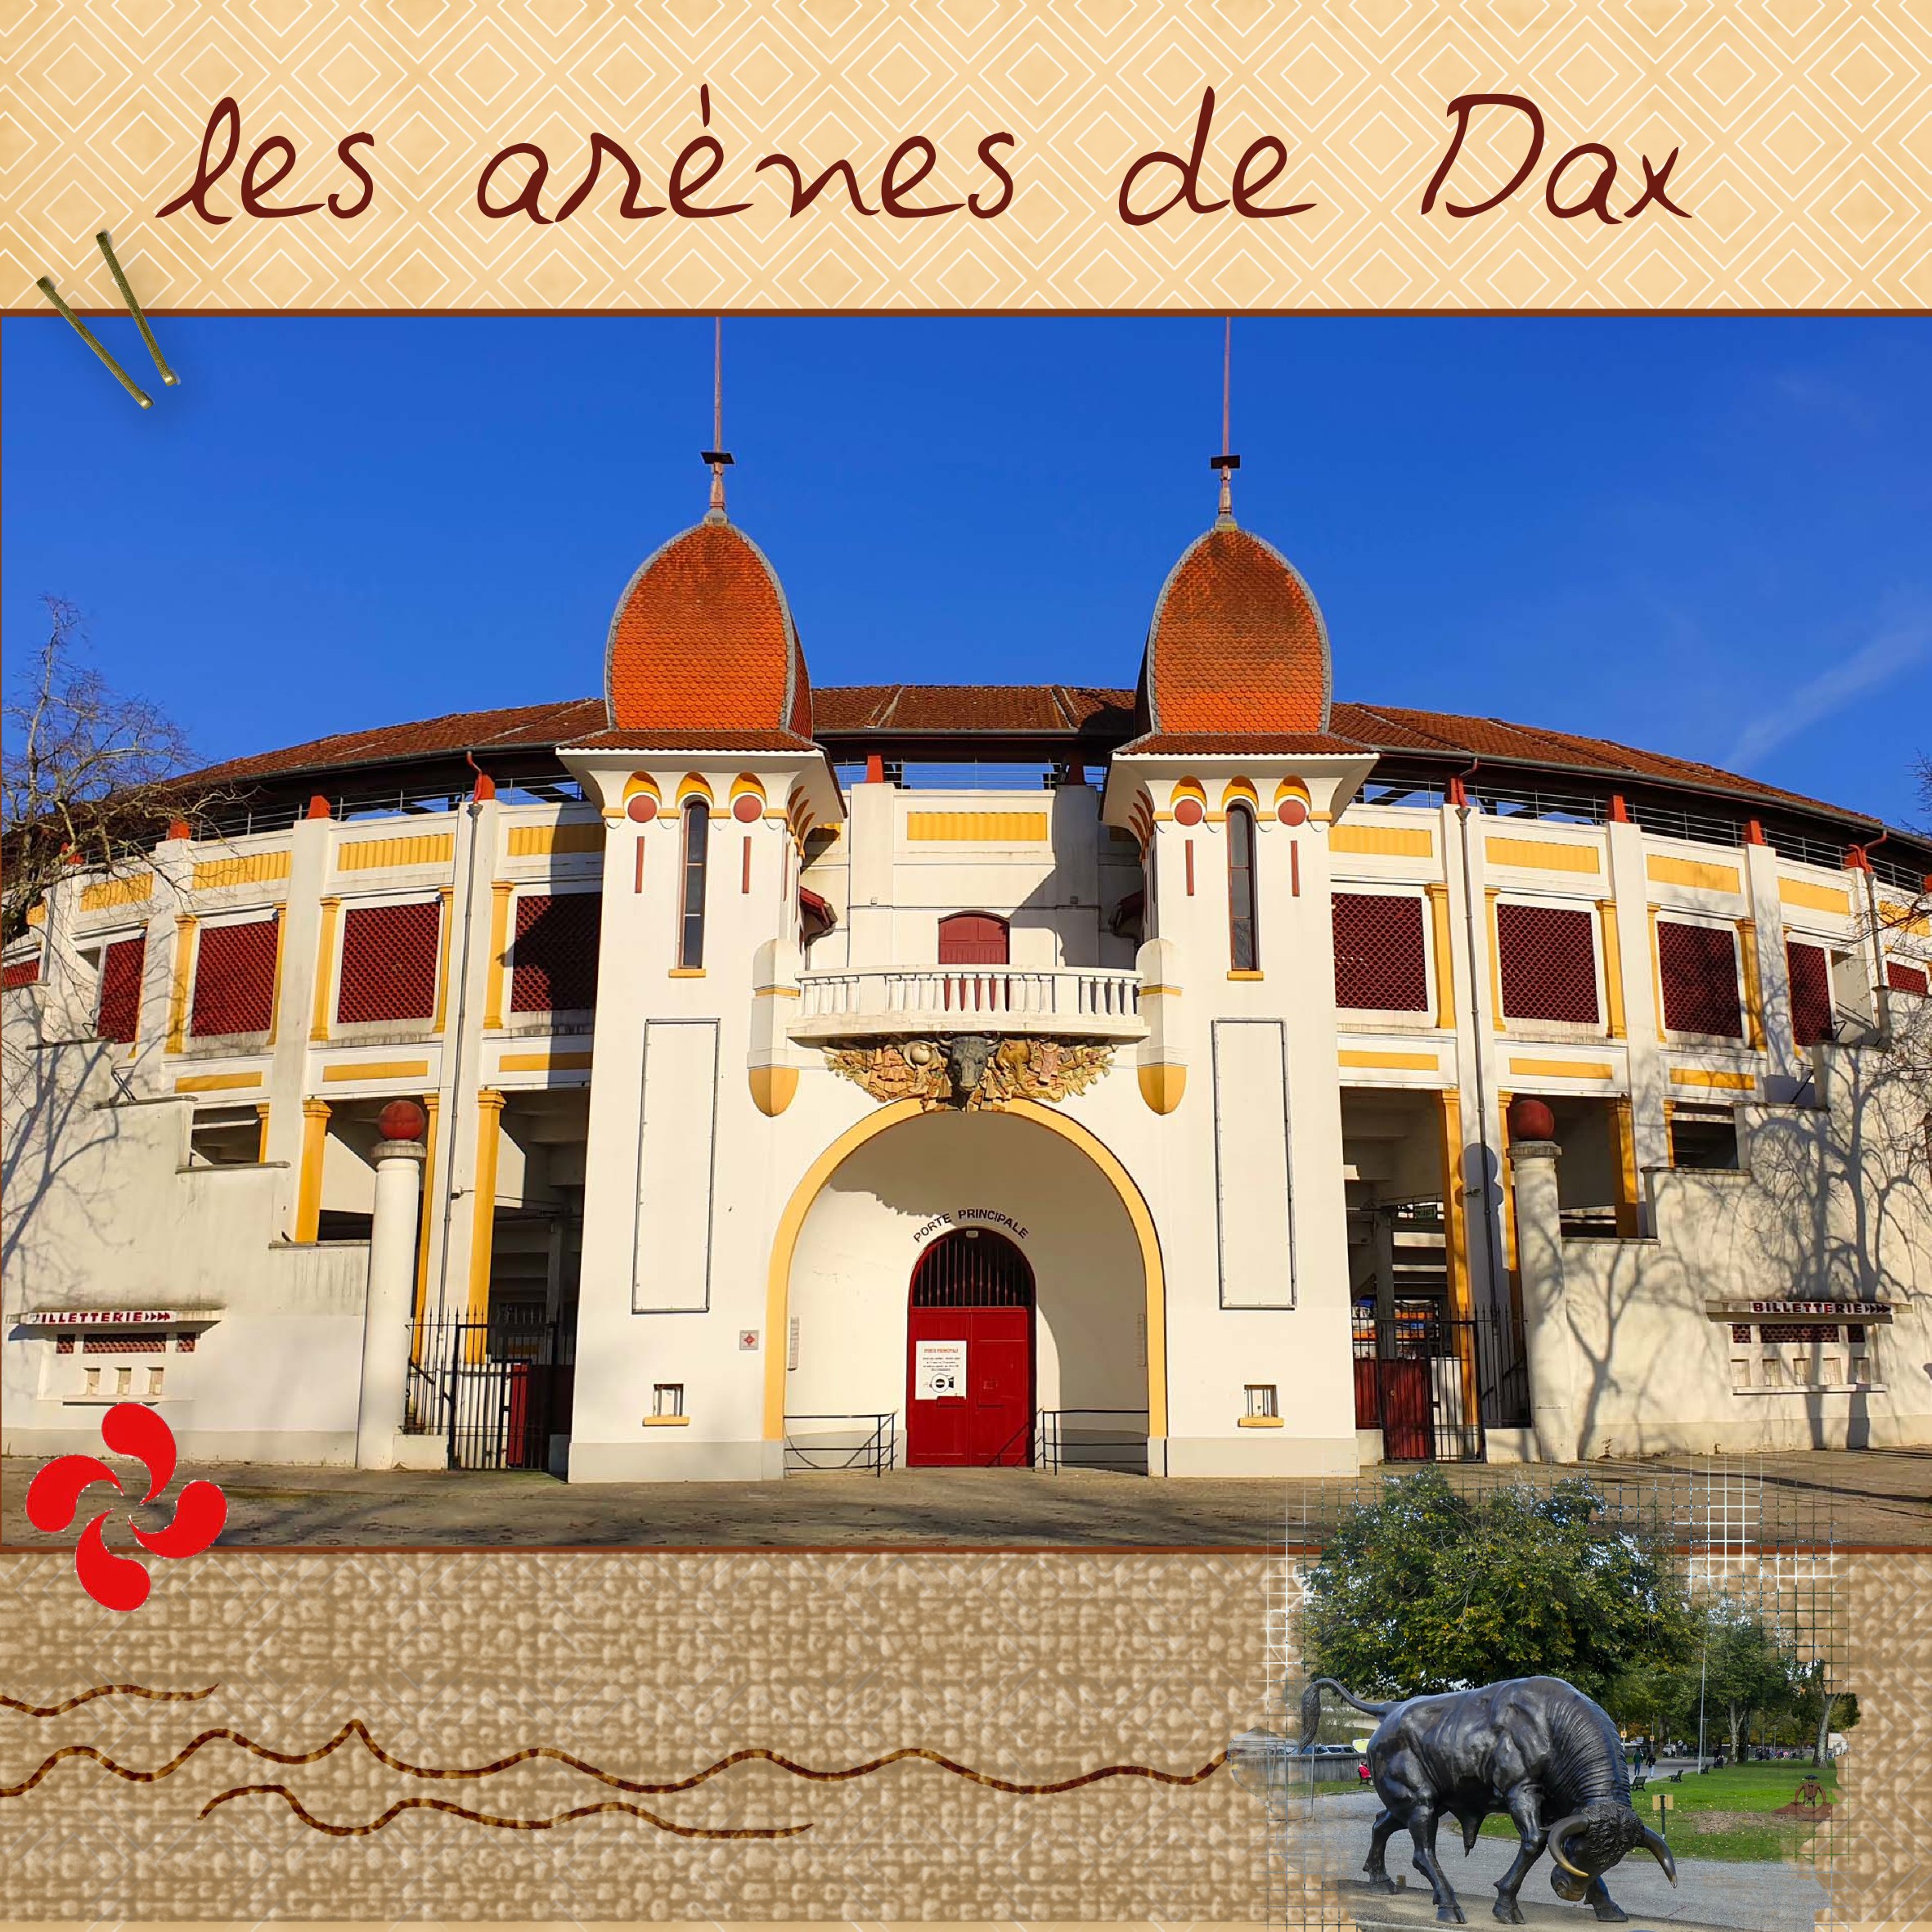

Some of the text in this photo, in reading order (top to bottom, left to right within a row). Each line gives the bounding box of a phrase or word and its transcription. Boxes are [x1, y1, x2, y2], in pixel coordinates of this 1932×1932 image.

[914, 1208, 1029, 1242] PORTE PRINCIPALE
[1753, 1302, 1862, 1313] BILLETTERIE
